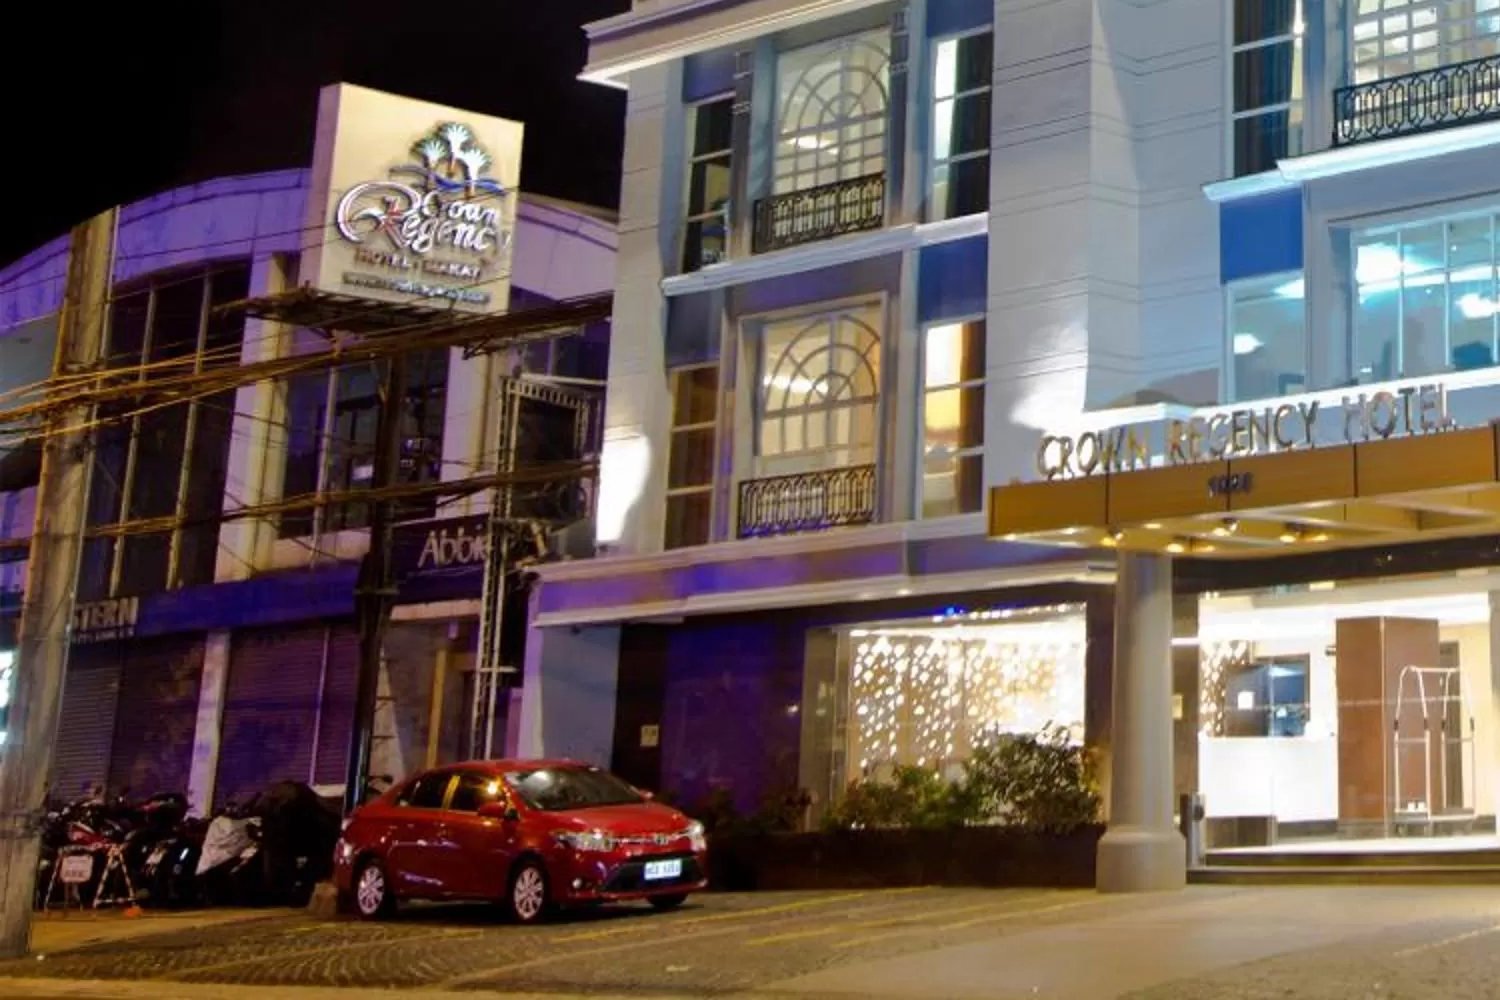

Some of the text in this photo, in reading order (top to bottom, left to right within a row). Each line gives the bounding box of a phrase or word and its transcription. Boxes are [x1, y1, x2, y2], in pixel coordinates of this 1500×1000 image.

[1037, 384, 1458, 479] CROWN REGENCY HOTEL
